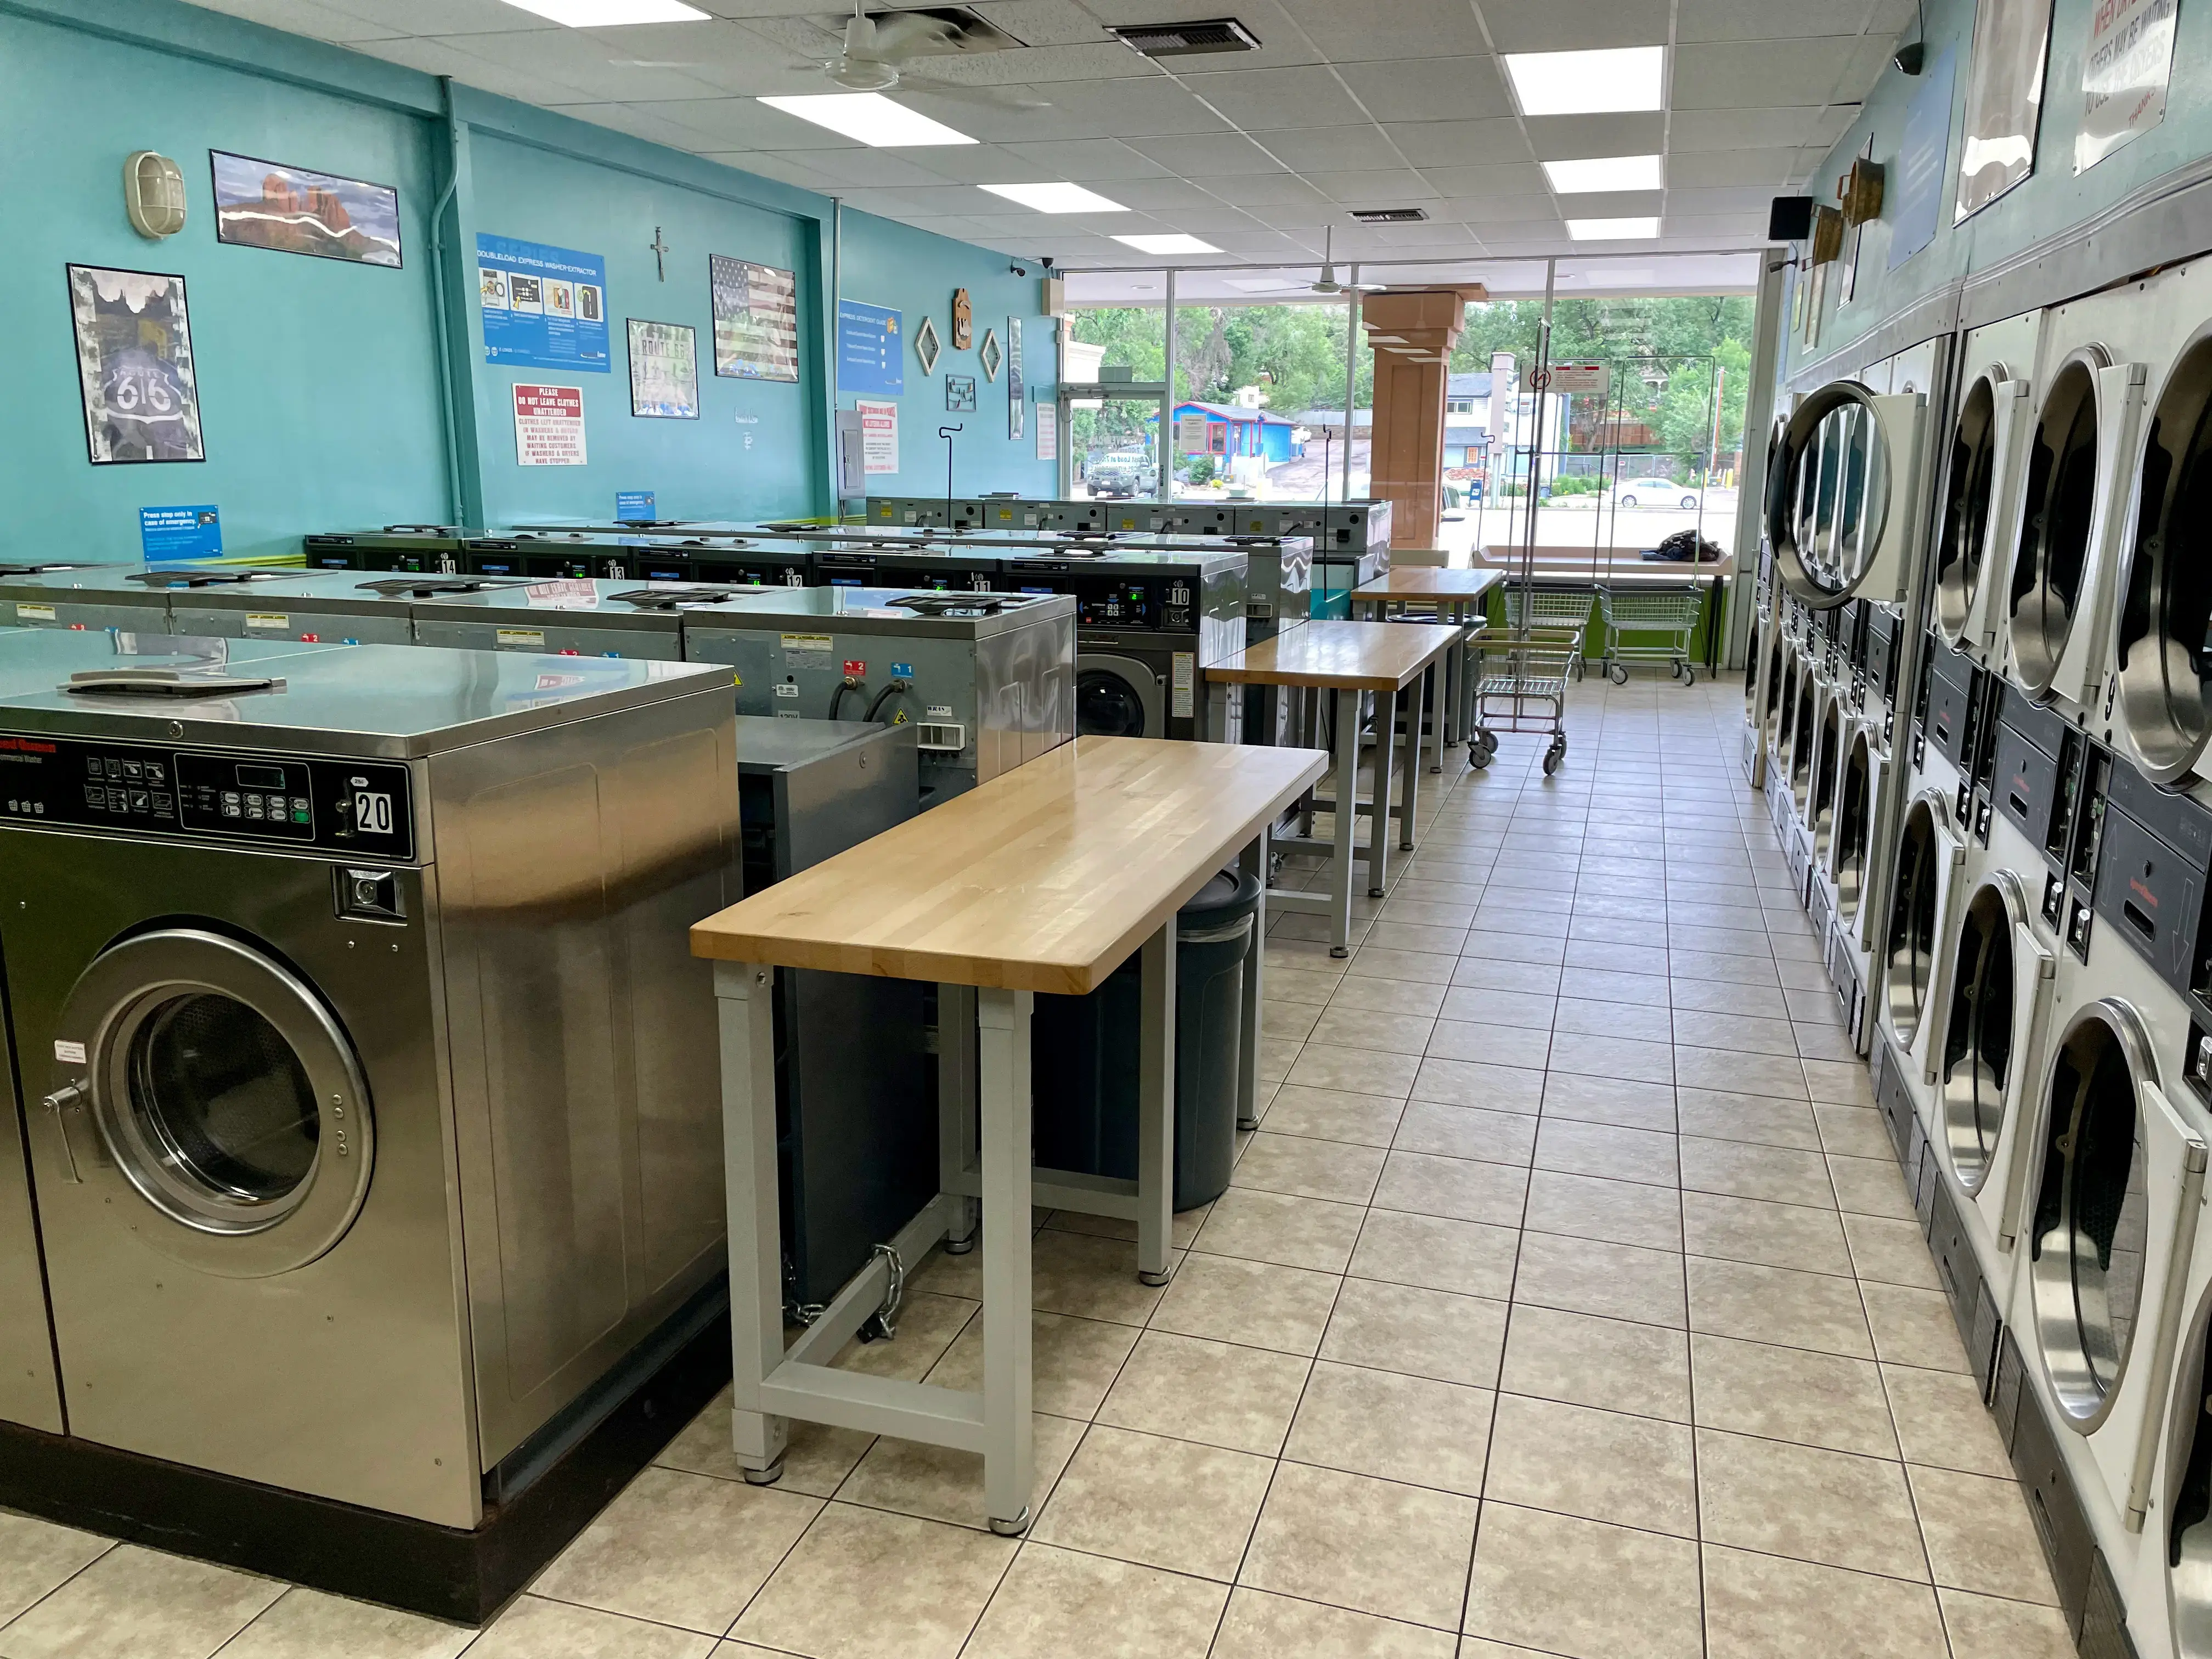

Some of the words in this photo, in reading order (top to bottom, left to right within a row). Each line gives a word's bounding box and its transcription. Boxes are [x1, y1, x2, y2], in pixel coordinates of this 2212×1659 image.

[2113, 25, 2129, 60] MAY
[2128, 15, 2140, 50] BE
[477, 250, 517, 263] DOUBLELOAD
[518, 257, 544, 267] EXPRESS
[642, 340, 670, 357] ROUTE
[674, 344, 685, 358] 66
[539, 388, 558, 397] PLEASE
[518, 397, 526, 405] DO
[527, 397, 538, 405] NOT
[540, 398, 556, 406] LEAVE
[557, 398, 579, 407] CLOTHES
[533, 408, 567, 416] UNATTENDED
[443, 561, 454, 574] 14
[611, 567, 623, 580] 13
[789, 575, 801, 587] 12
[976, 582, 988, 592] 11
[1174, 589, 1188, 604] 10
[858, 662, 864, 670] 2
[907, 665, 912, 673] 1
[2104, 674, 2115, 721] 9
[358, 794, 390, 831] 20
